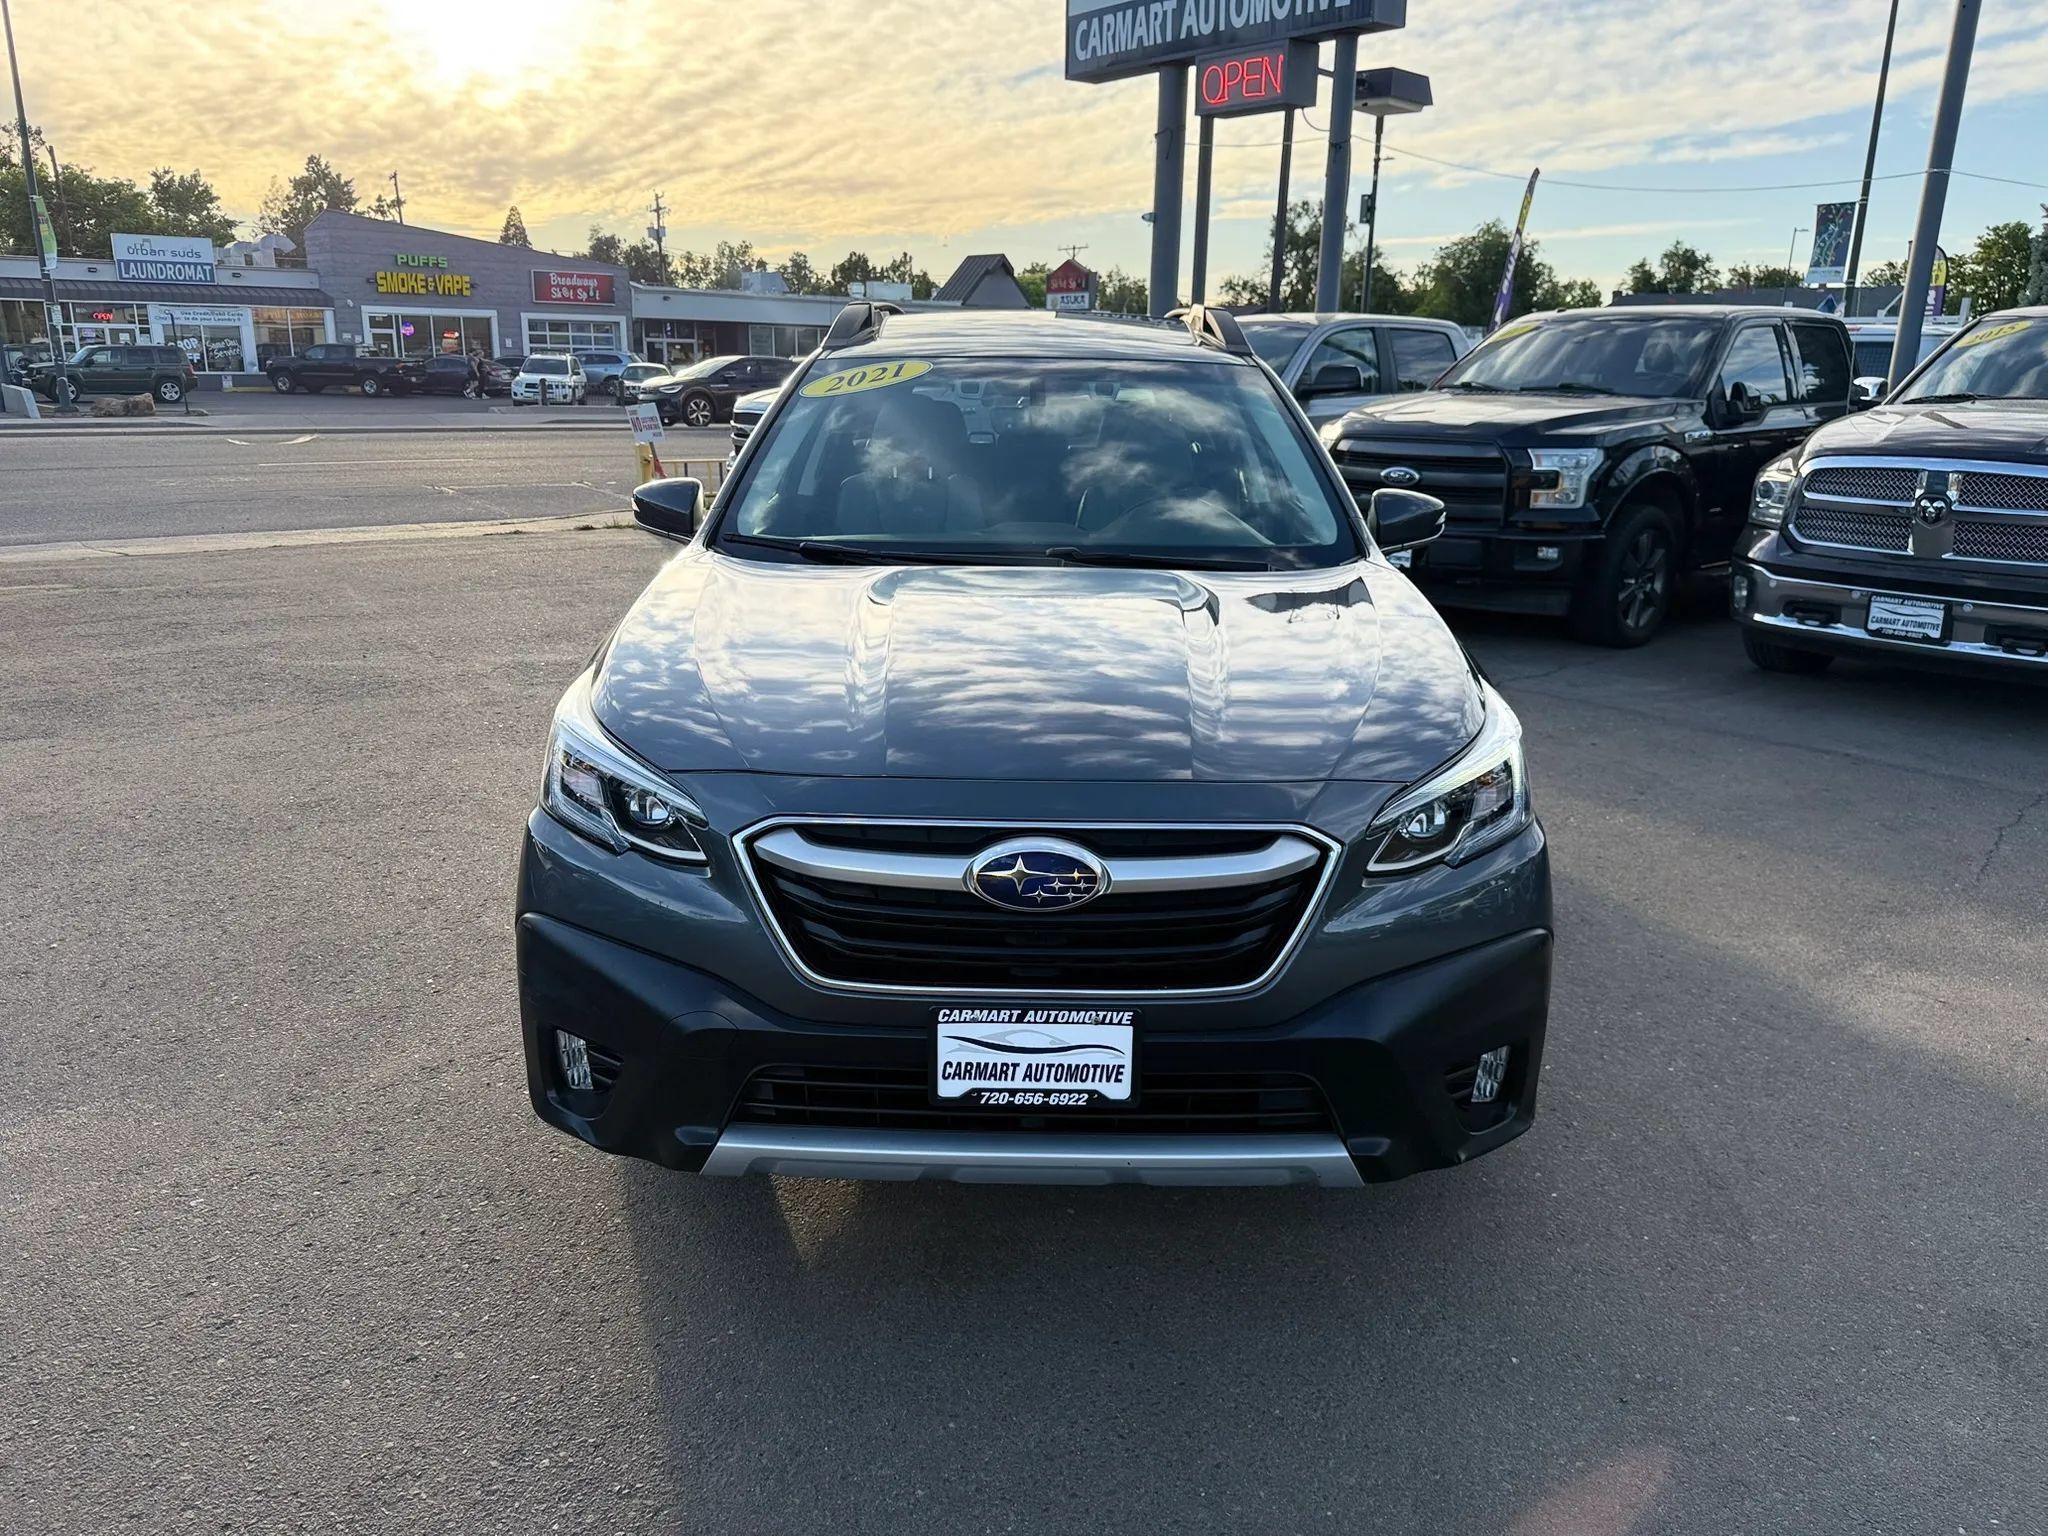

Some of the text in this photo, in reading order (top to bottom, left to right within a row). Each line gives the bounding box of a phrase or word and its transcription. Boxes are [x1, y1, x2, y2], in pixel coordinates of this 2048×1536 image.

[1075, 0, 1351, 61] CARMART AUTOMO
[1202, 54, 1284, 104] OPEN
[170, 248, 202, 259] suds
[396, 253, 449, 268] PUFFS
[120, 261, 212, 281] LAUNDROMAT
[376, 271, 471, 296] SMOKE & VAPE
[93, 312, 113, 320] OPEN
[825, 363, 906, 392] 2021
[1870, 615, 1940, 631] CARMART AUTOMOTIVE
[938, 1009, 1134, 1025] CARMART AUTOMOTIVE
[941, 1060, 1126, 1083] CARMART AUTOMOTIVE
[979, 1091, 1089, 1105] 720-656-6922
